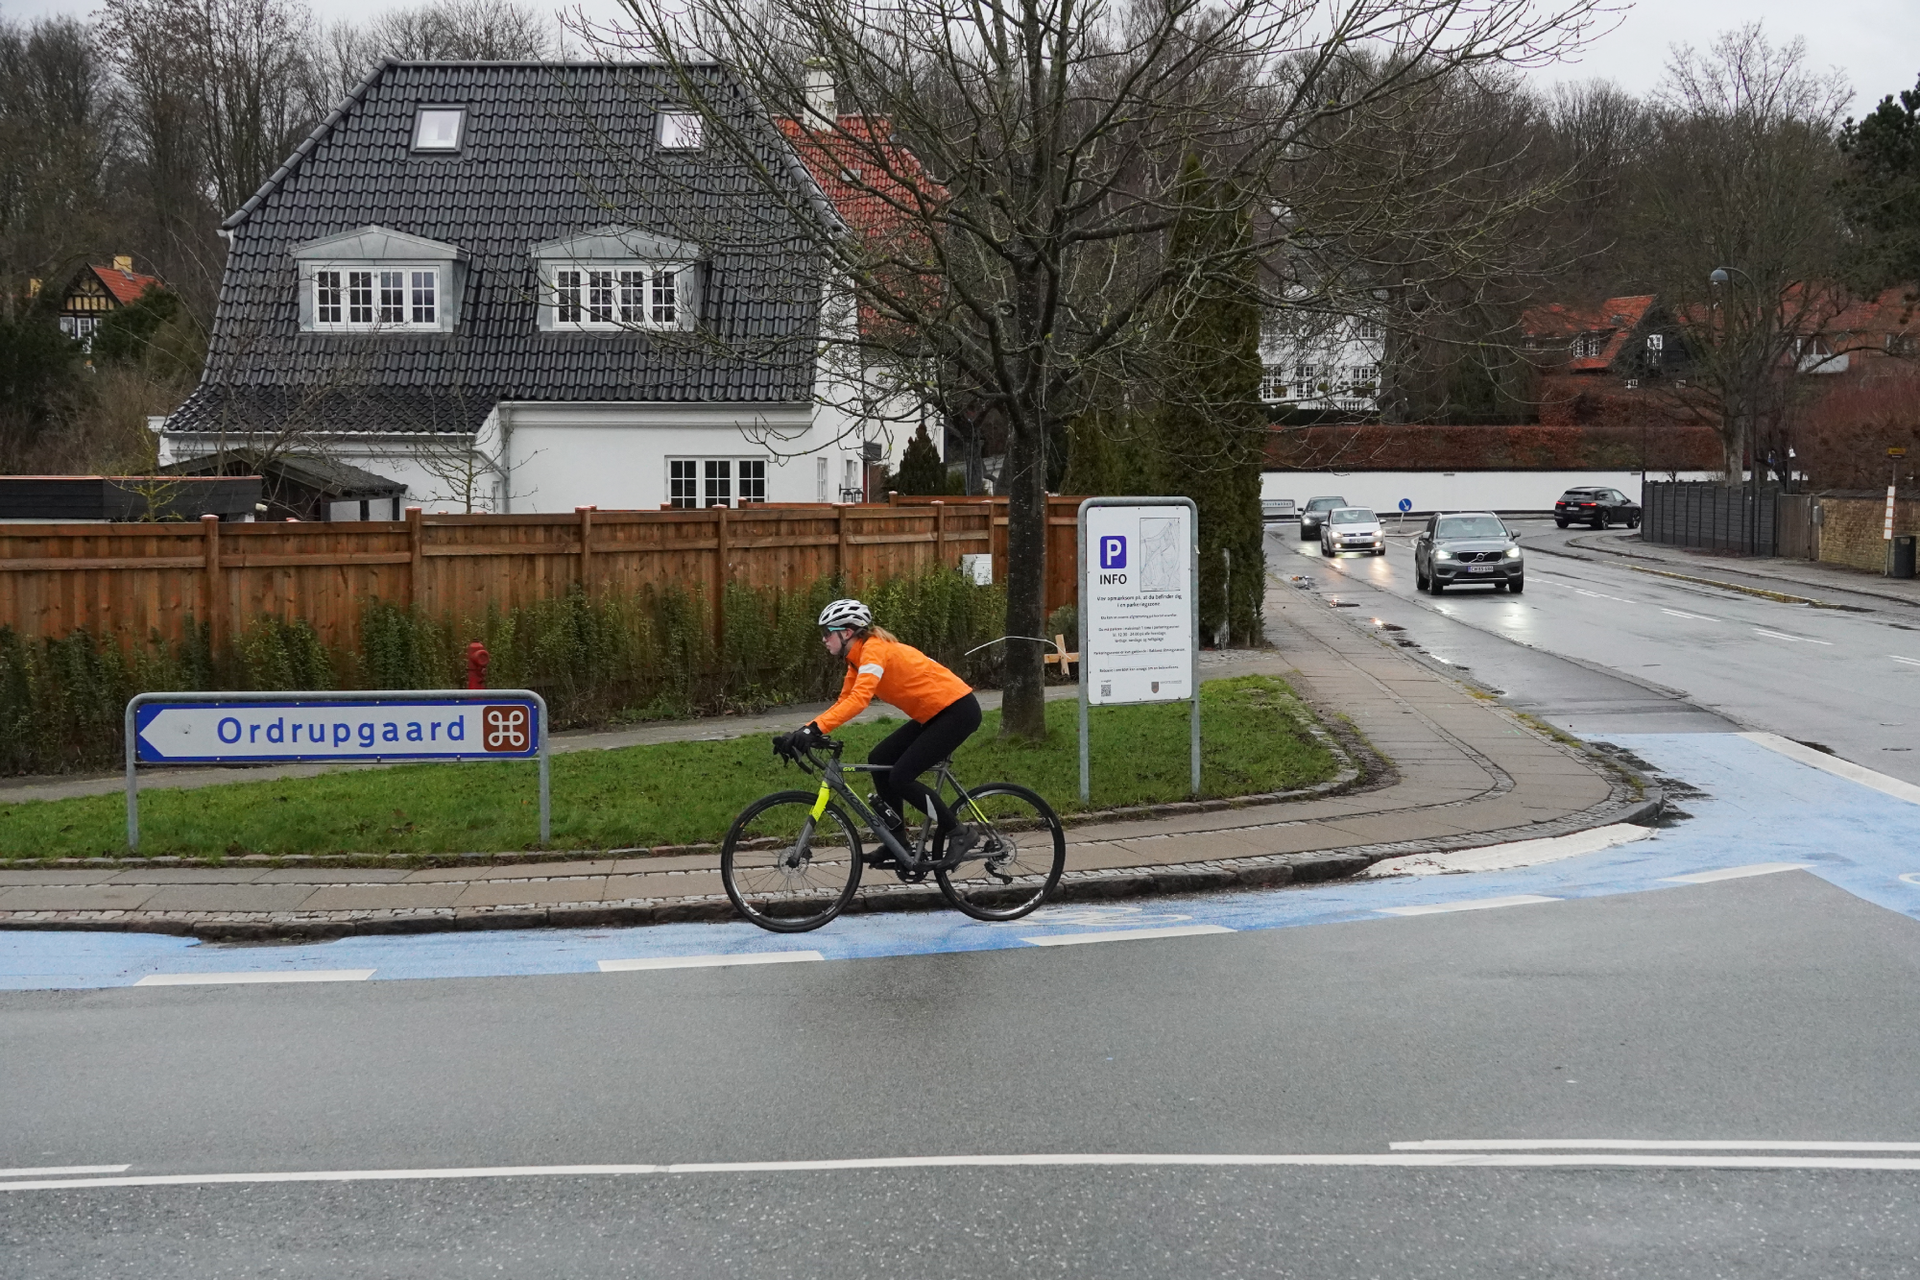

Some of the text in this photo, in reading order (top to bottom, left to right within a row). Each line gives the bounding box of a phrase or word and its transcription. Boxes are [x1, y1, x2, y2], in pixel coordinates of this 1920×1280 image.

[1106, 539, 1122, 566] P
[1100, 574, 1127, 585] INFO
[217, 714, 465, 748] Ordrupgaard
[840, 785, 881, 828] MOSSO
